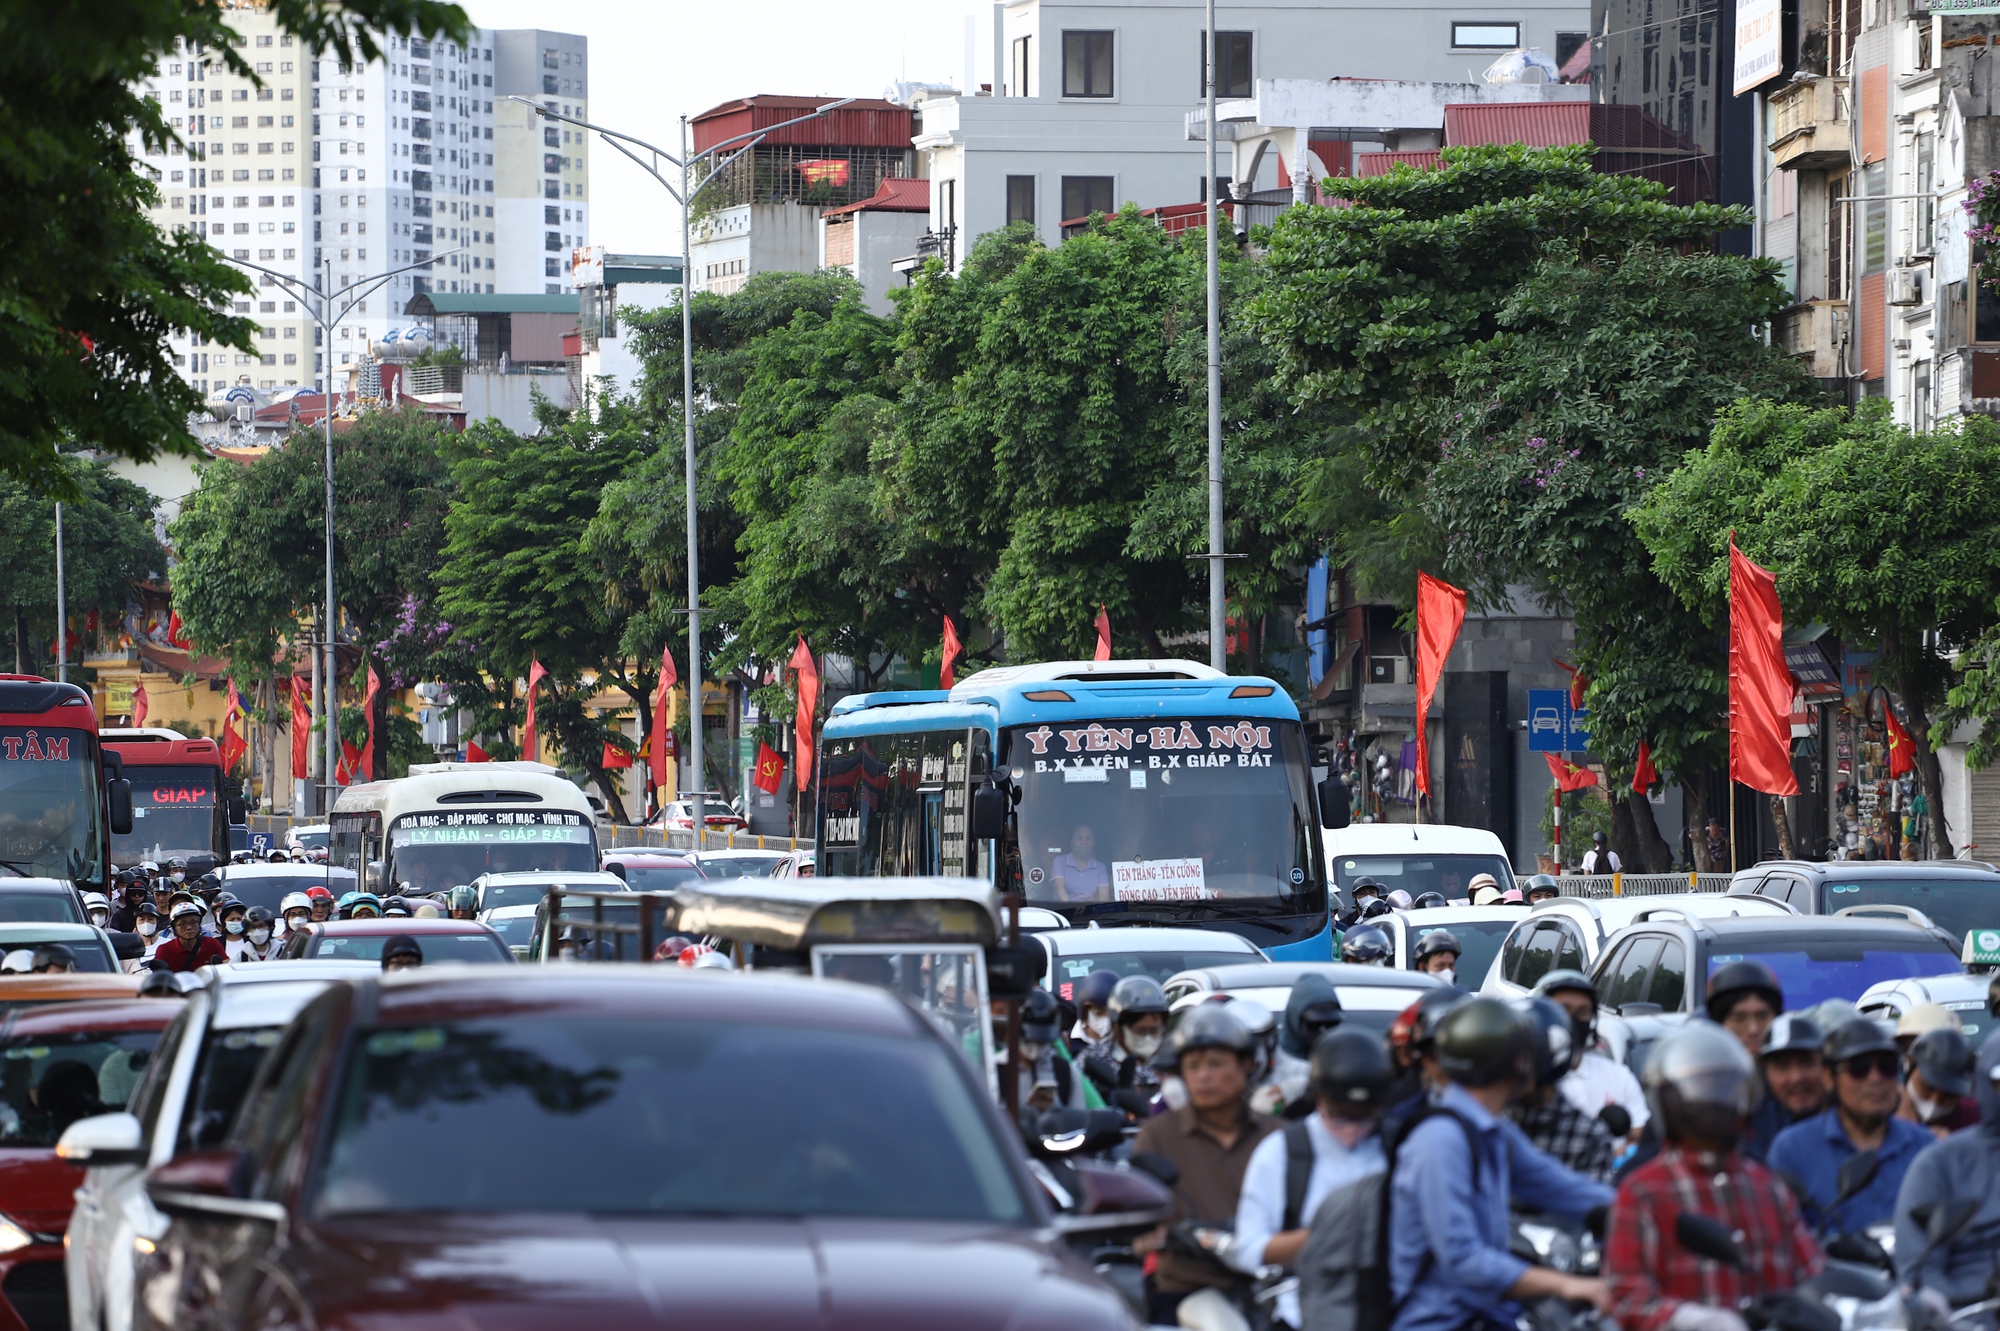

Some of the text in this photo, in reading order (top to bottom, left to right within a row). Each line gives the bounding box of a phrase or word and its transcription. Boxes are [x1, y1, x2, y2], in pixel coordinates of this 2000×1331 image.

[2, 730, 70, 761] TÂM
[1025, 725, 1054, 754] Ý
[1207, 720, 1272, 753] NỘI
[1034, 758, 1067, 773] B.X
[1072, 754, 1085, 771] Ý
[1090, 754, 1129, 770] YÊN
[1148, 755, 1181, 768] B.X
[1186, 751, 1231, 768] GIÁP
[1237, 751, 1273, 767] BÁT
[152, 787, 207, 803] GIAP
[400, 815, 418, 829] HOÀ
[420, 815, 440, 828] MẠC
[466, 811, 489, 825] PHÚC
[496, 812, 514, 825] CHỢ
[515, 812, 536, 825] MẠC
[411, 827, 573, 842] LÝ NHÂN GIÁP BÁT
[1116, 865, 1131, 882] YÊN
